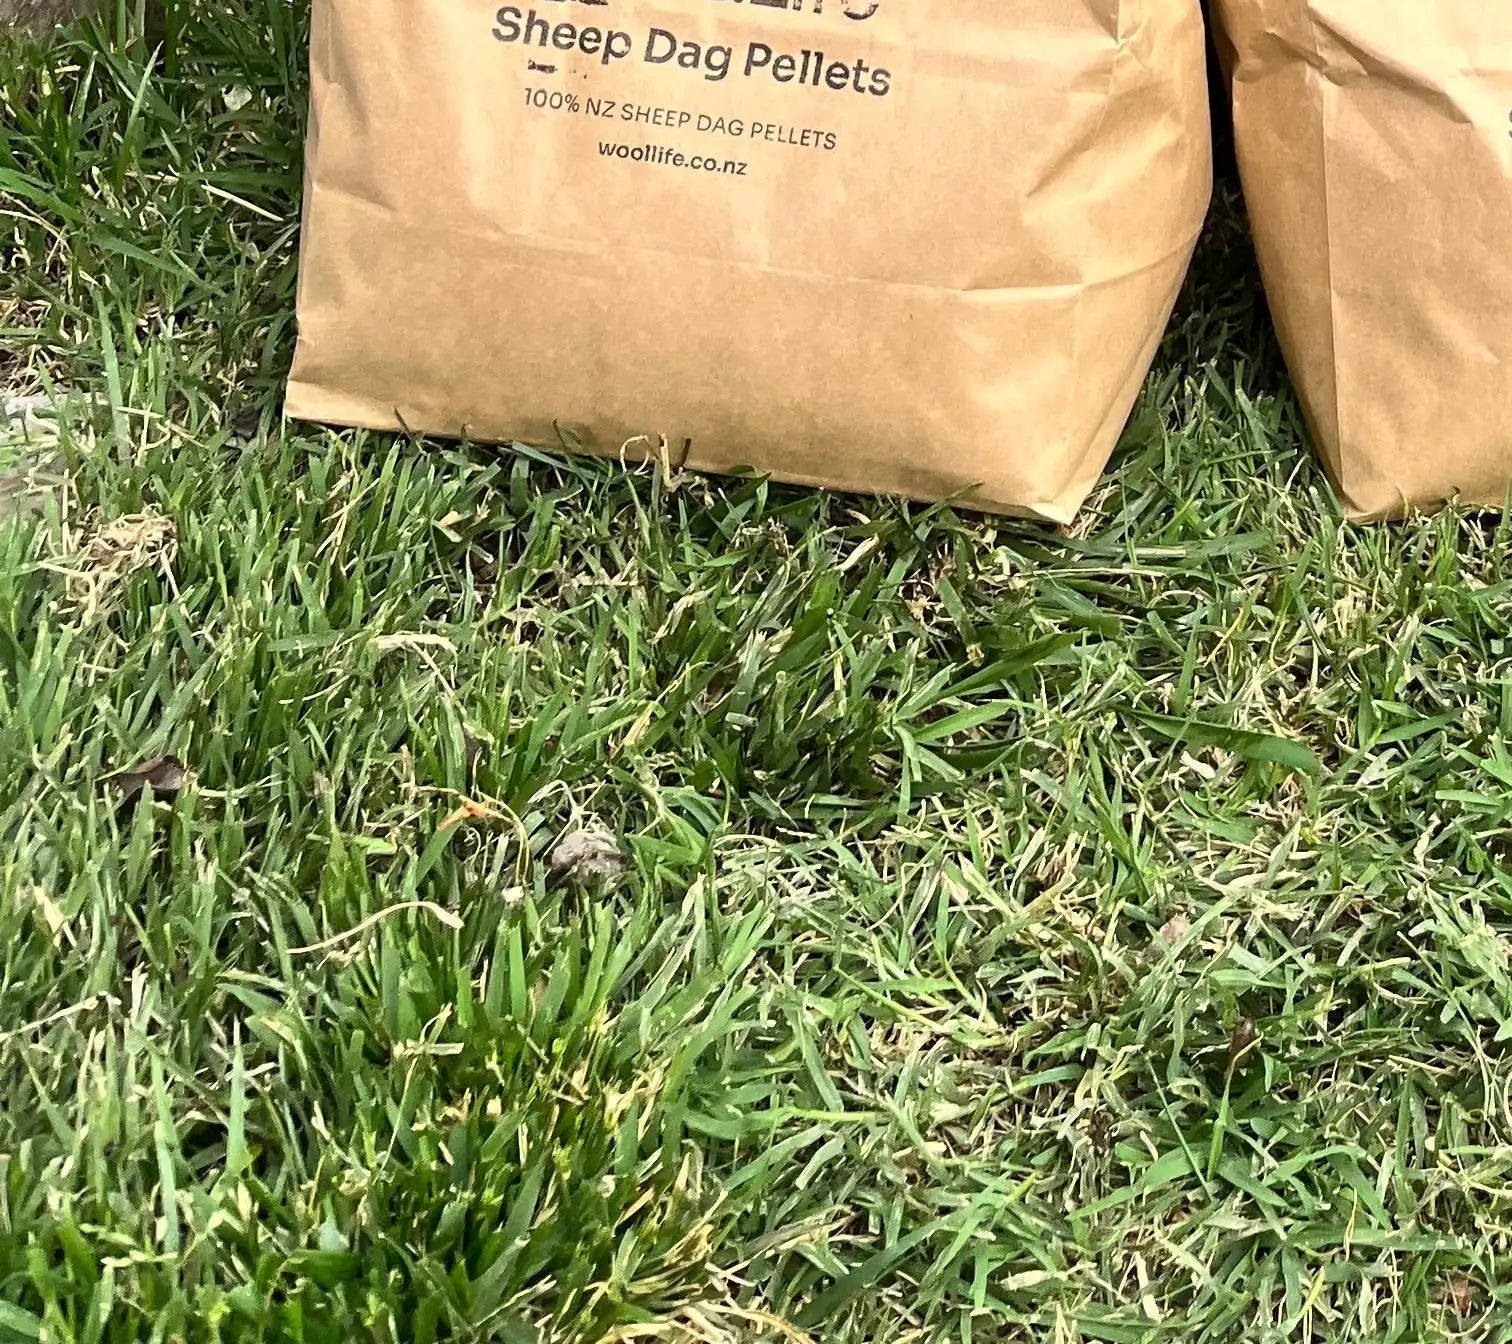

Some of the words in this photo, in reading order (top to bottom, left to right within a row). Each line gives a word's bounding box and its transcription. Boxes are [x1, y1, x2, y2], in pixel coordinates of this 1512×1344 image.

[491, 5, 632, 64] Sheep
[643, 27, 733, 82] Dag
[743, 42, 893, 96] Pellets
[523, 86, 581, 114] 100%
[585, 96, 616, 119] NZ
[620, 103, 692, 129] SHEEP
[695, 113, 745, 138] DAG
[749, 122, 838, 151] PELLETS
[597, 140, 749, 176] woollife.co.nz
